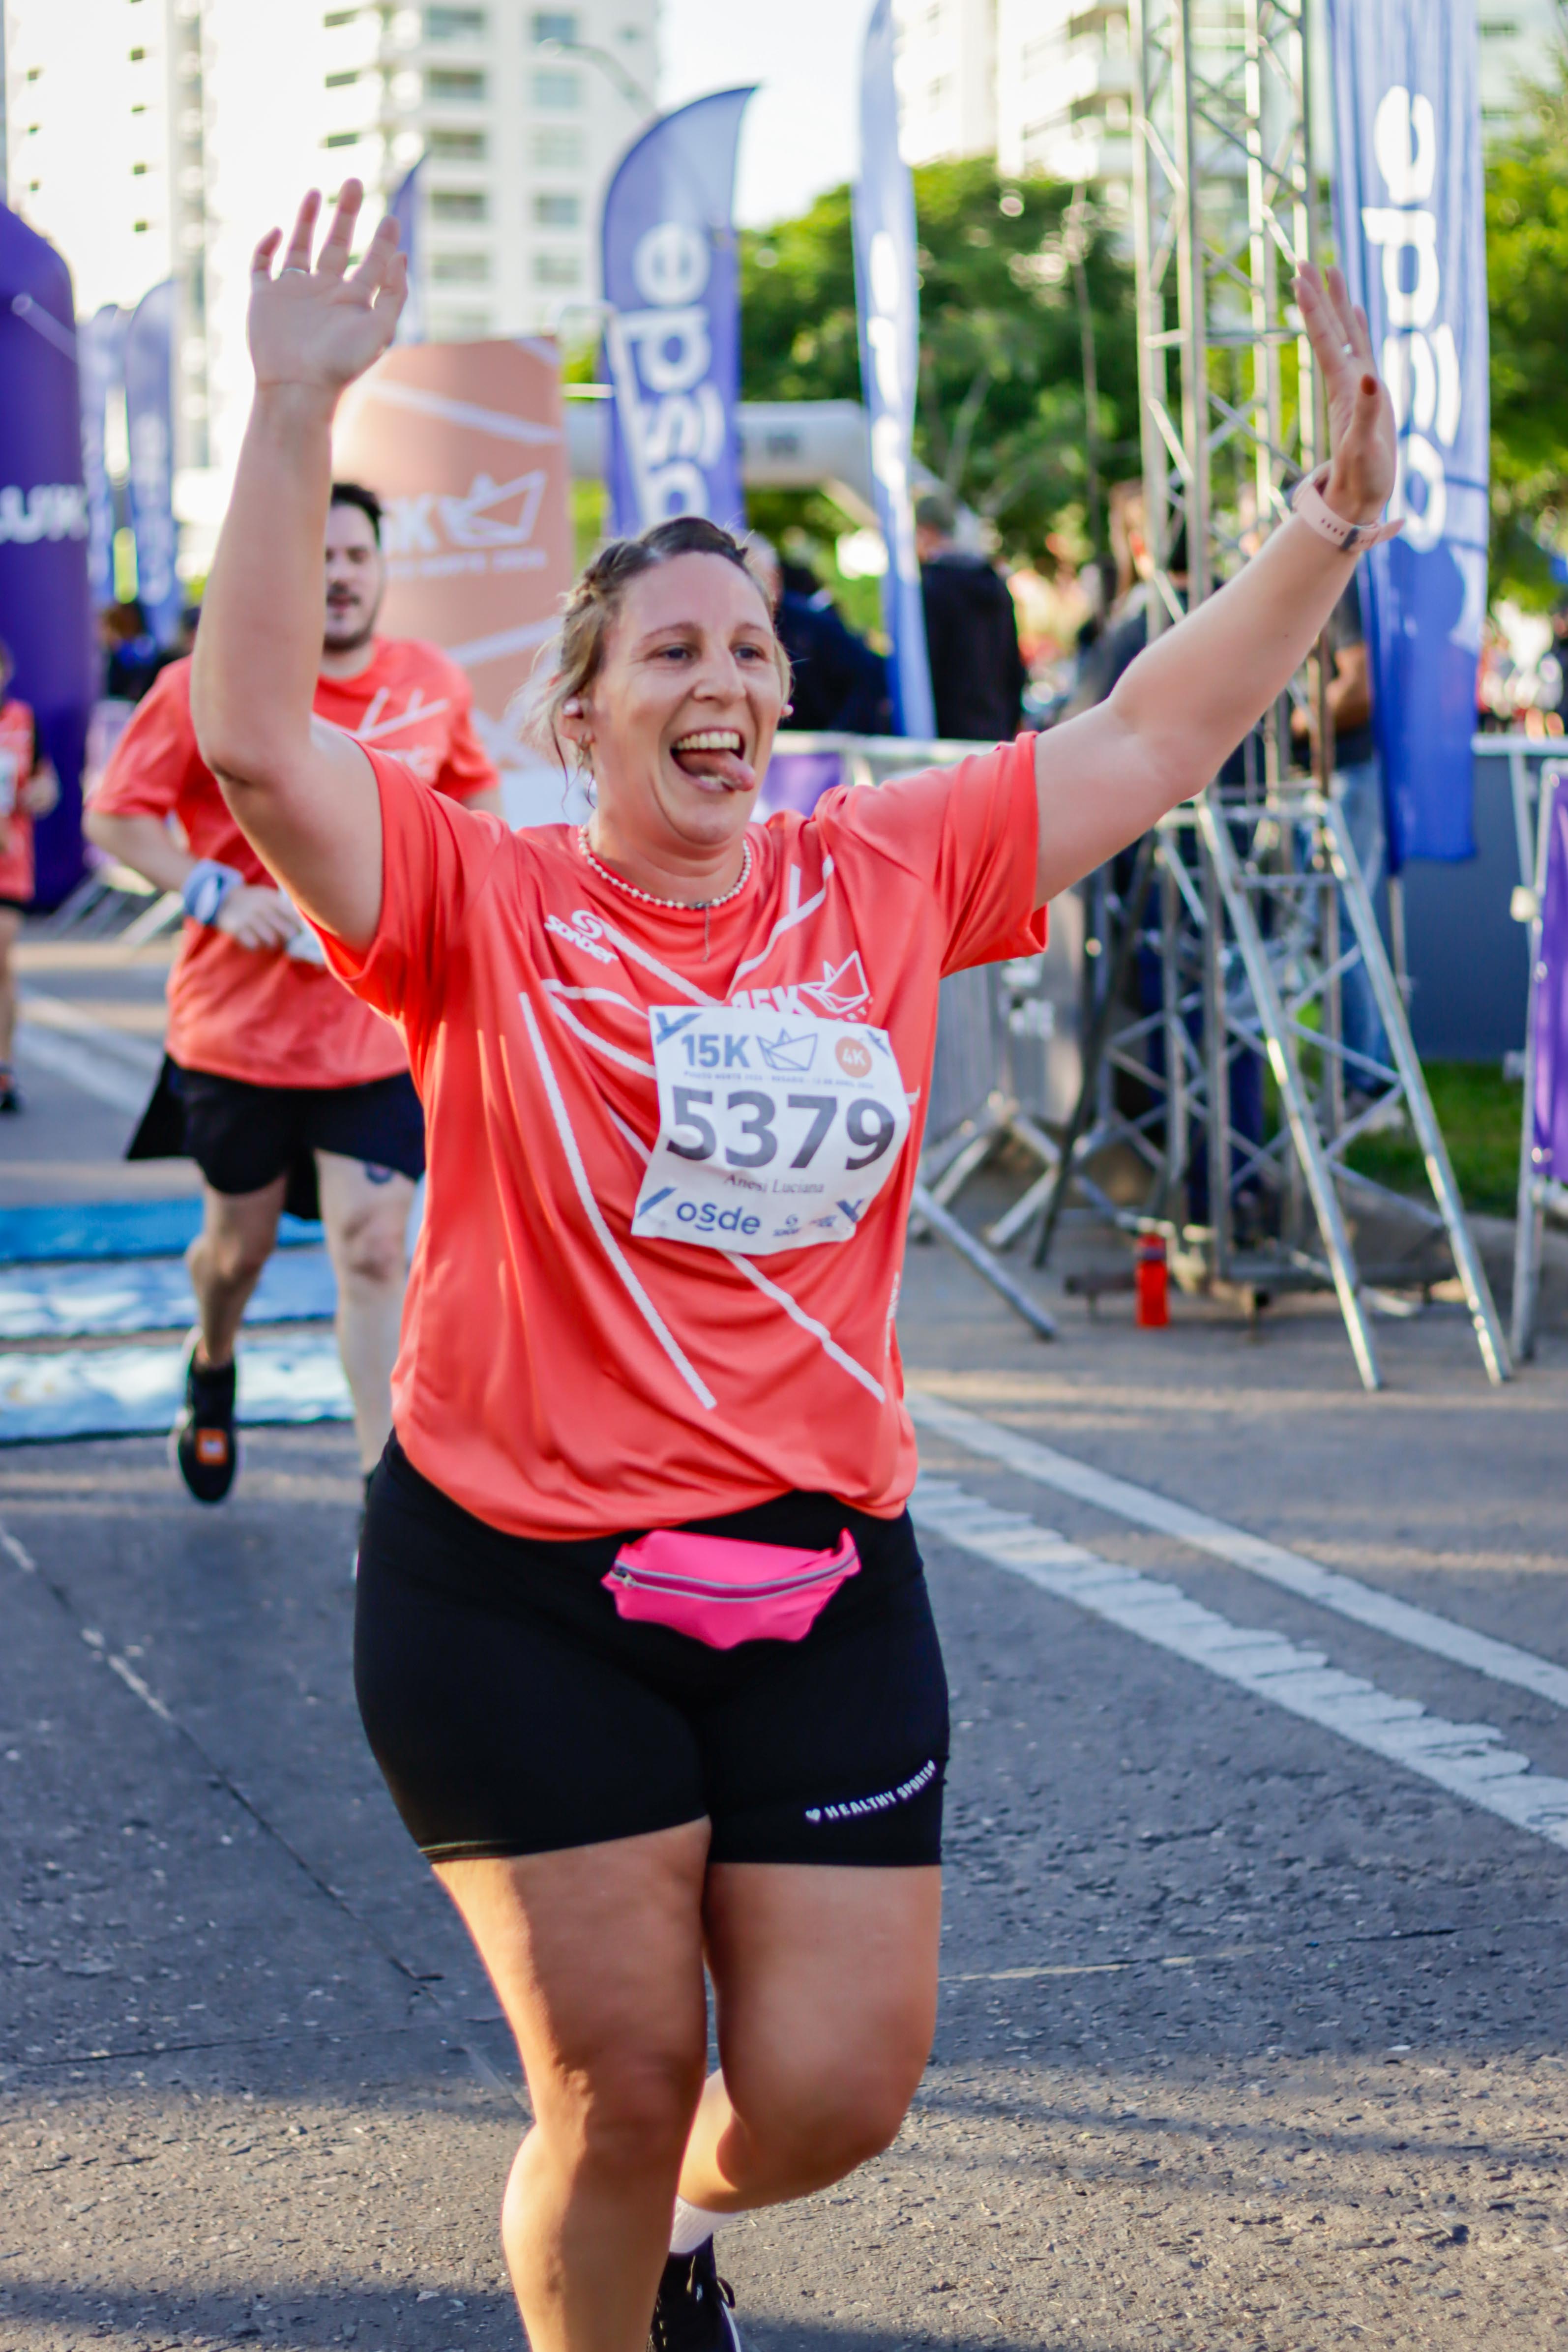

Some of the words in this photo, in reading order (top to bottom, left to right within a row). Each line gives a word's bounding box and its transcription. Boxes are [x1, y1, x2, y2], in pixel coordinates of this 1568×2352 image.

[680, 1034, 751, 1068] 15K
[842, 1047, 866, 1066] 4K
[666, 1085, 895, 1171] 5379
[772, 1178, 825, 1194] Luciana
[677, 1202, 761, 1235] osde
[824, 1791, 897, 1818] HEALTHY
